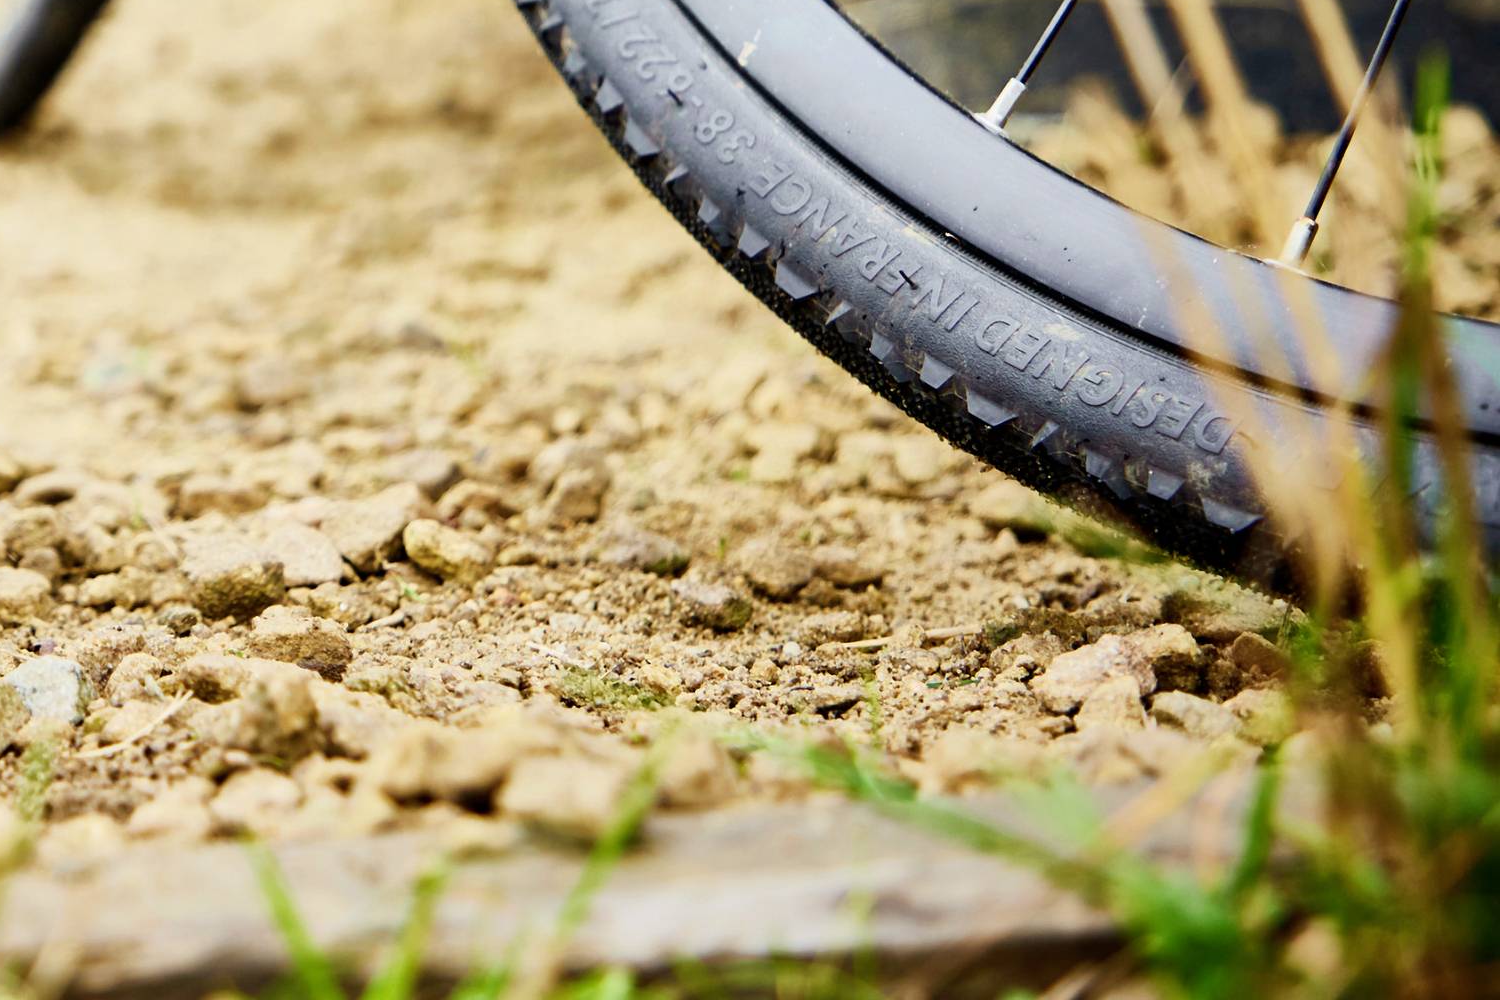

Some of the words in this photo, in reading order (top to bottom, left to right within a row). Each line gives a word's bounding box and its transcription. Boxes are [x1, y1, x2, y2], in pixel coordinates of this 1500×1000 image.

[749, 162, 924, 297] FRANCE
[912, 278, 981, 333] IN
[974, 313, 1242, 455] DESIGNED
